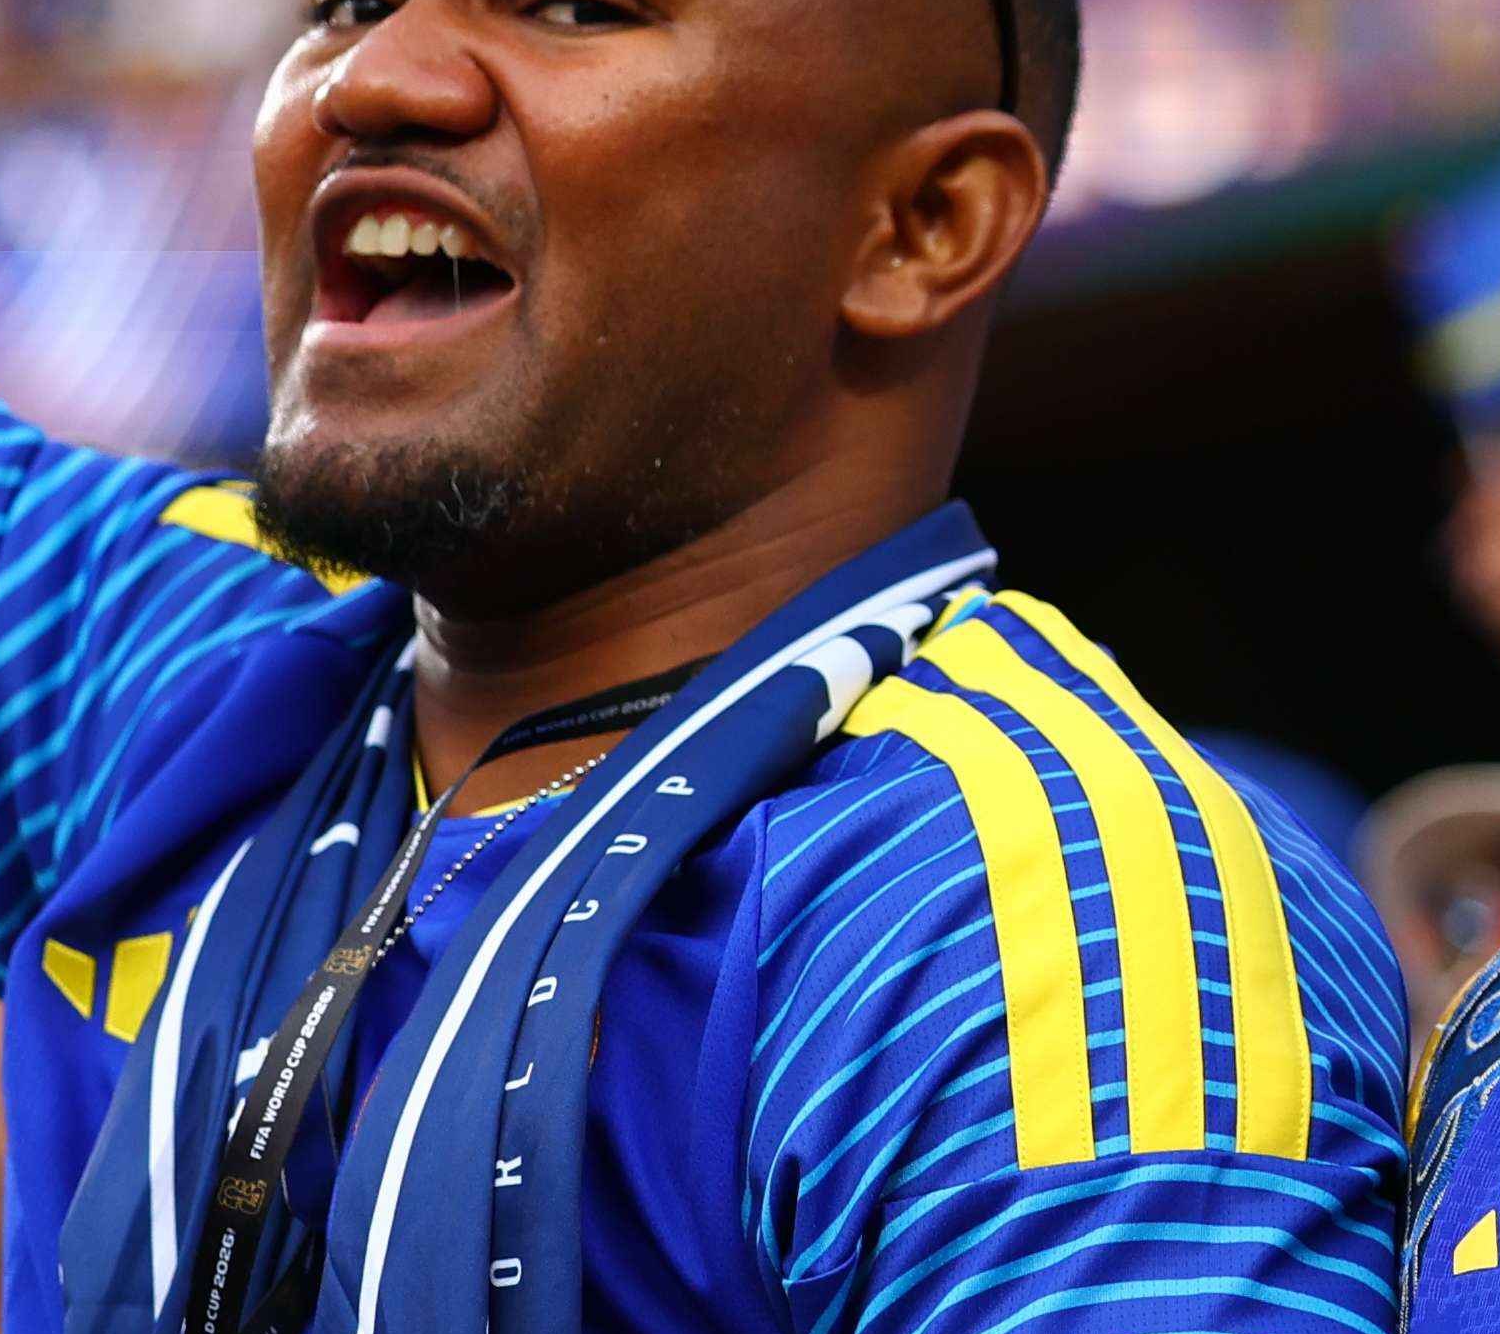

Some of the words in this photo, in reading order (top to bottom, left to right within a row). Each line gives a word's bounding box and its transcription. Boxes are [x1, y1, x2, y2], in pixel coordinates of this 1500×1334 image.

[249, 1124, 272, 1161] FIFA
[263, 1066, 296, 1120] WORLD
[285, 1037, 308, 1070] CUP
[300, 985, 337, 1041] 2026
[212, 1227, 236, 1290] 2026
[206, 1289, 223, 1322] CUP
